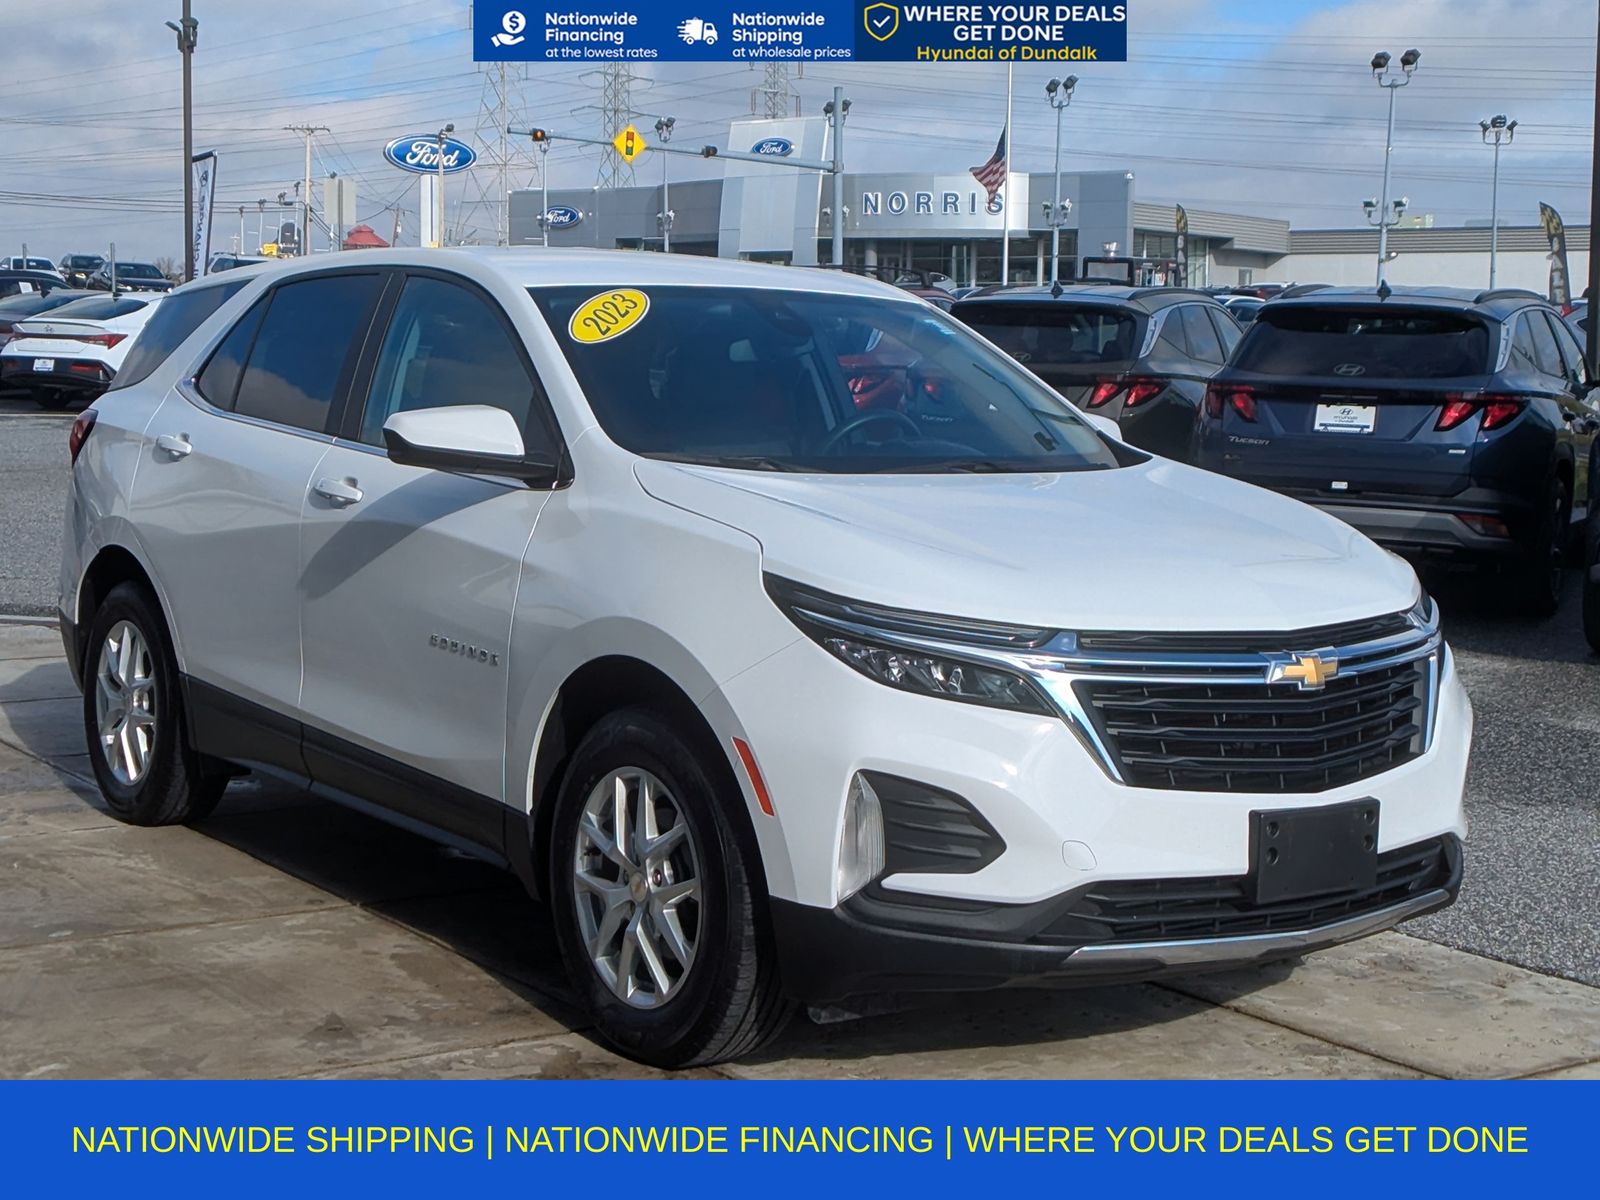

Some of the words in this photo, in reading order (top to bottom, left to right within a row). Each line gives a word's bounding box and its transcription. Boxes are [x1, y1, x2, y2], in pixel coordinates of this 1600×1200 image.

[759, 141, 783, 154] Ford
[547, 209, 571, 223] Ford
[862, 190, 1005, 216] NORRIS
[582, 293, 638, 336] 2023
[430, 633, 499, 666] EQUINOX
